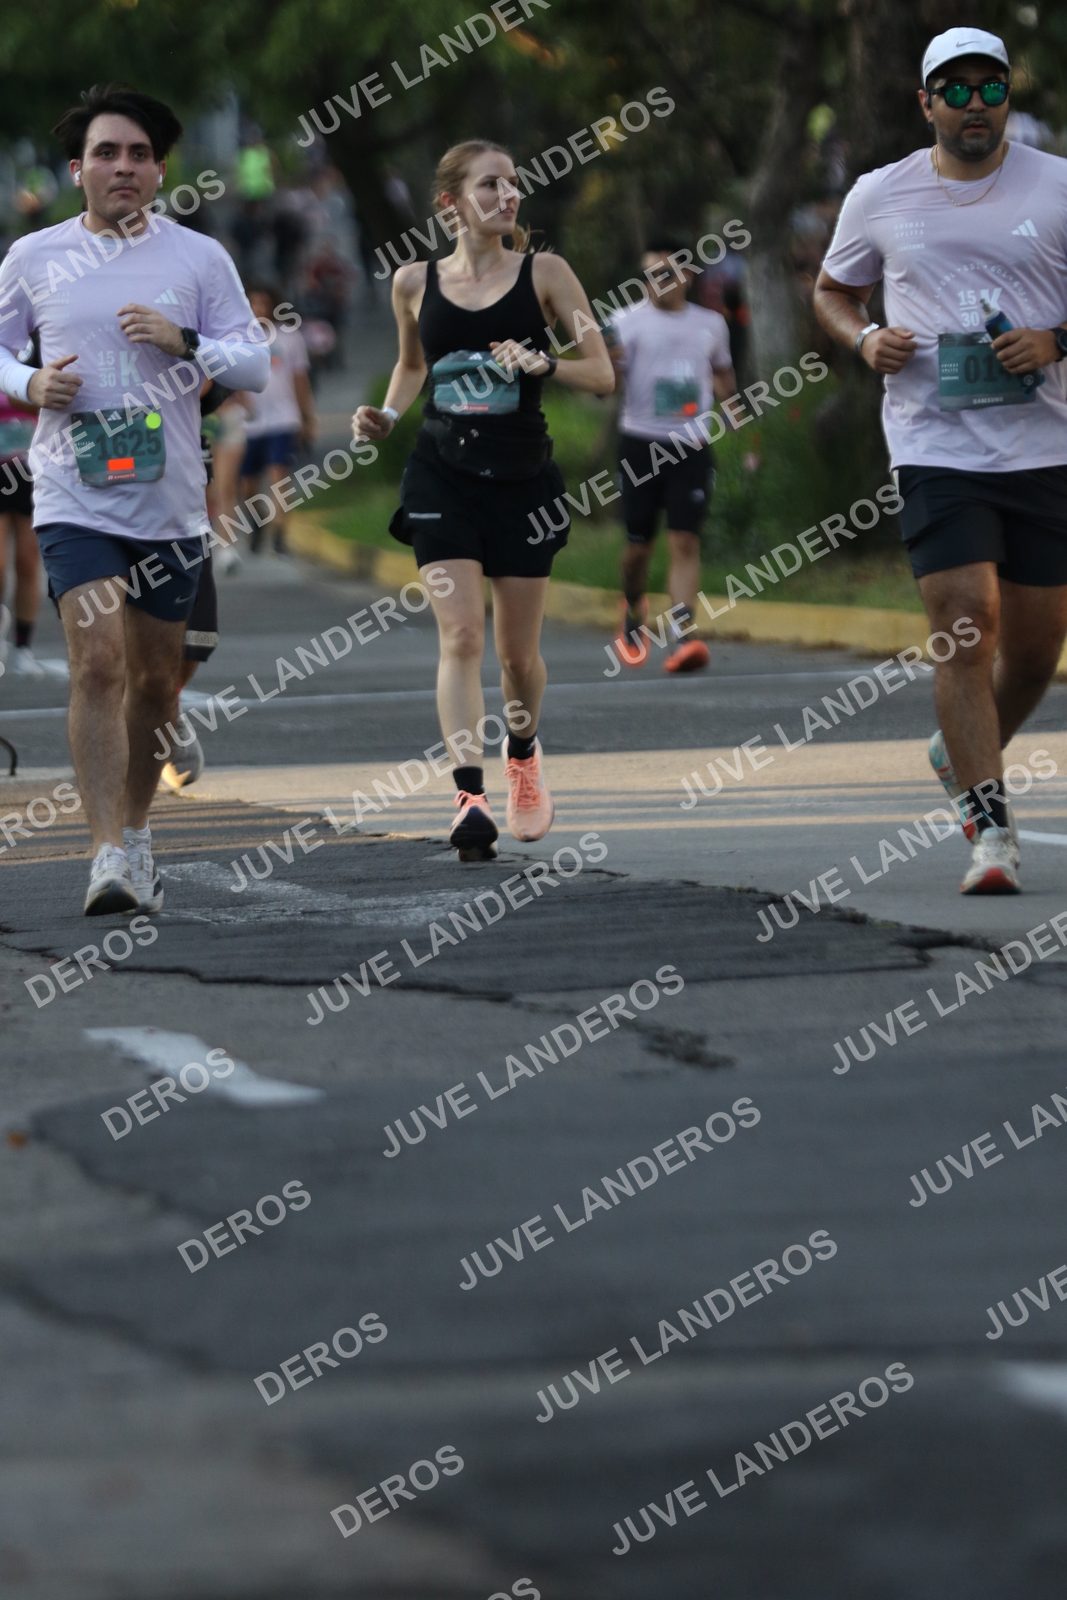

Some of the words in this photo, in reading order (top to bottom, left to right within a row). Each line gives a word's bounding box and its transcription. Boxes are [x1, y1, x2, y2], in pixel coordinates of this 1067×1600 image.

[958, 290, 976, 306] 15
[961, 311, 980, 327] 30
[97, 350, 115, 367] 15
[119, 350, 142, 387] K
[964, 354, 998, 384] 01
[98, 371, 117, 388] 30
[96, 428, 162, 460] 1625
